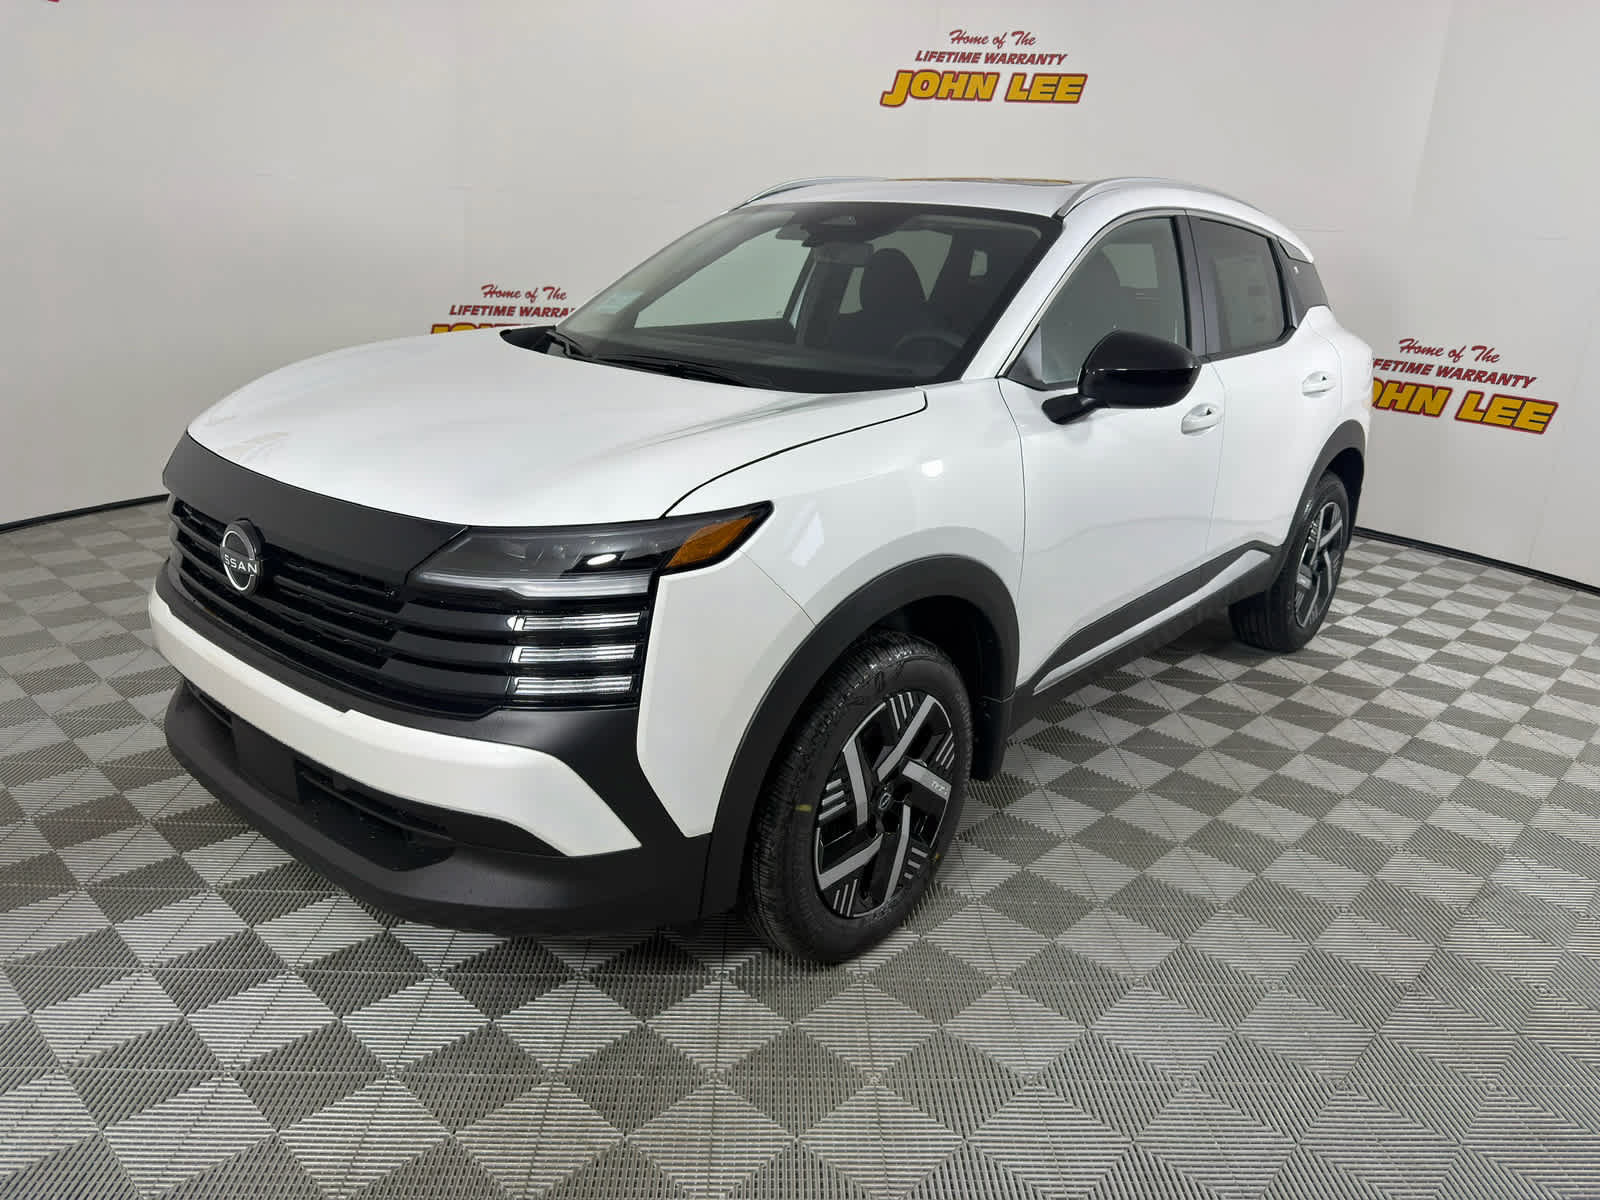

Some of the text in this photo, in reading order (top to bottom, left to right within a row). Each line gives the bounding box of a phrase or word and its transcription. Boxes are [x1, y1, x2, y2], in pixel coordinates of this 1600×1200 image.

[949, 29, 1037, 49] Home of The
[915, 50, 1067, 65] LIFETIME WARRANTY
[880, 69, 1088, 107] JOHN LEE
[481, 284, 567, 303] Home of The
[449, 304, 575, 318] LIFETIME WARRA
[1398, 338, 1500, 363] Home of The
[1372, 358, 1537, 388] FETIME WARRANTY
[1454, 390, 1559, 434] LEE
